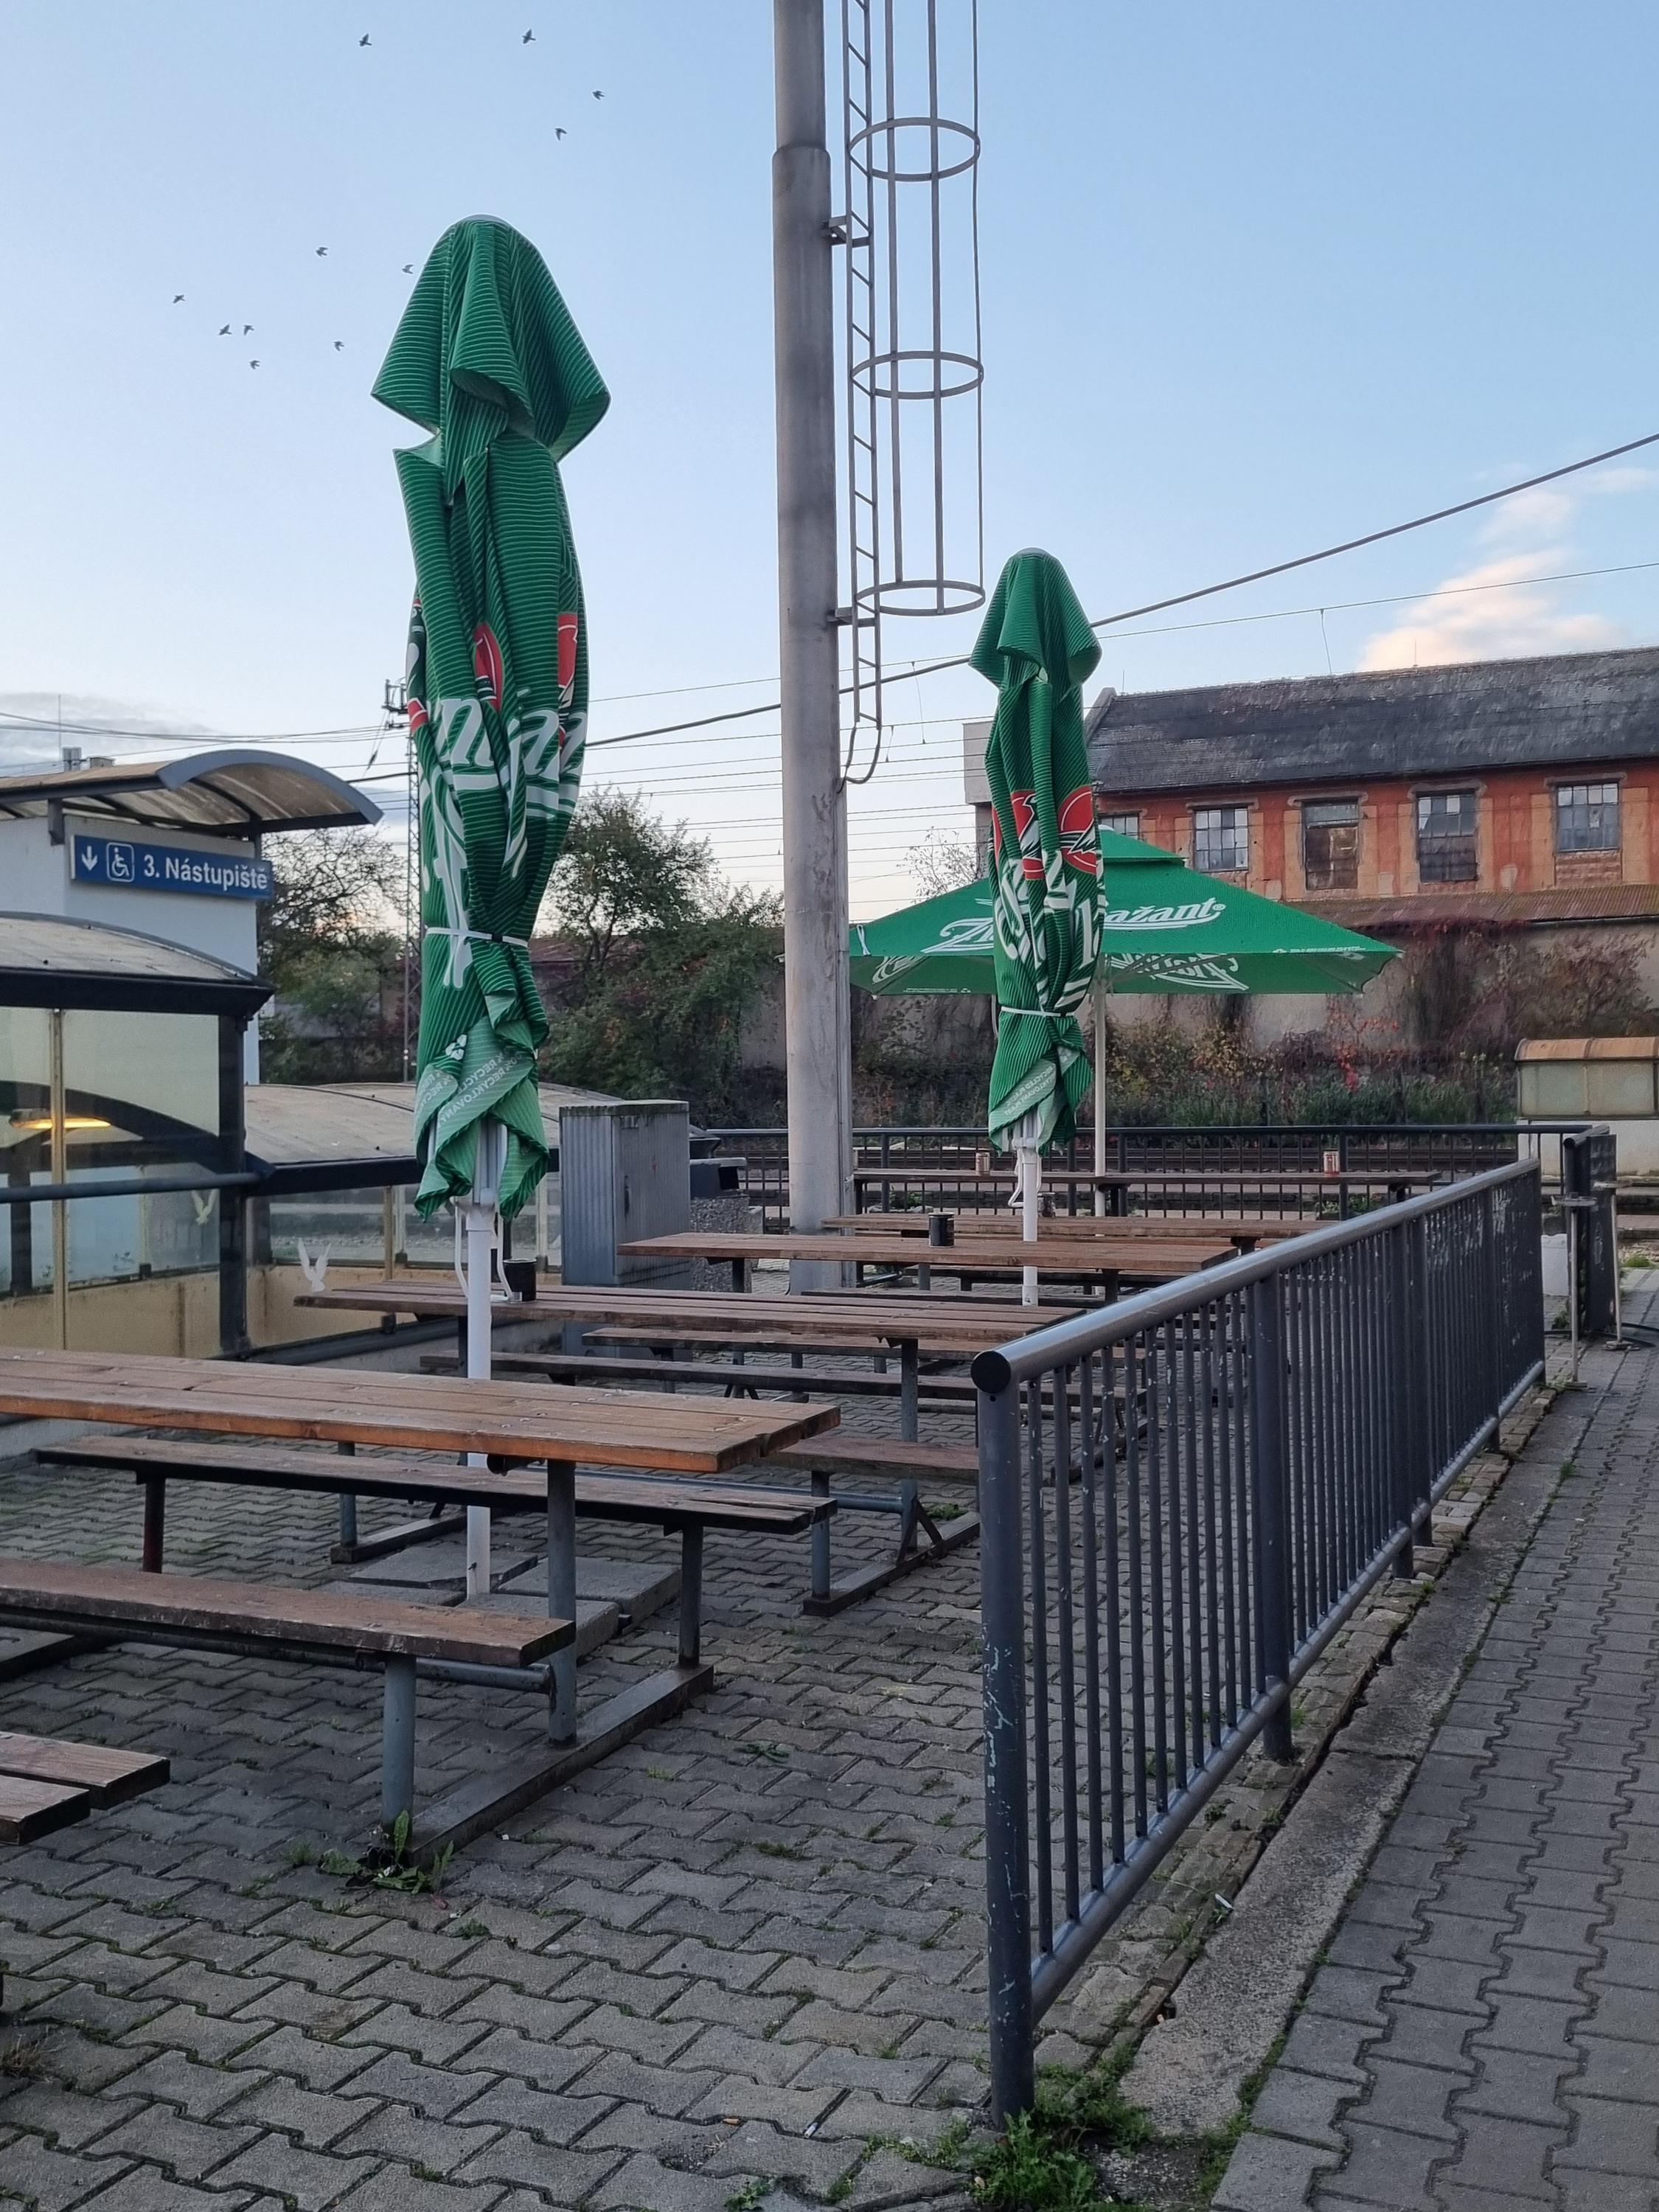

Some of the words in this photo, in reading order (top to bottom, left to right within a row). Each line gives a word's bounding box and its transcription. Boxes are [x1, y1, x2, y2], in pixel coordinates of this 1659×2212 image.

[143, 854, 161, 878] 3.
[165, 858, 268, 891] Nástupiště
[1104, 897, 1222, 930] ažant
